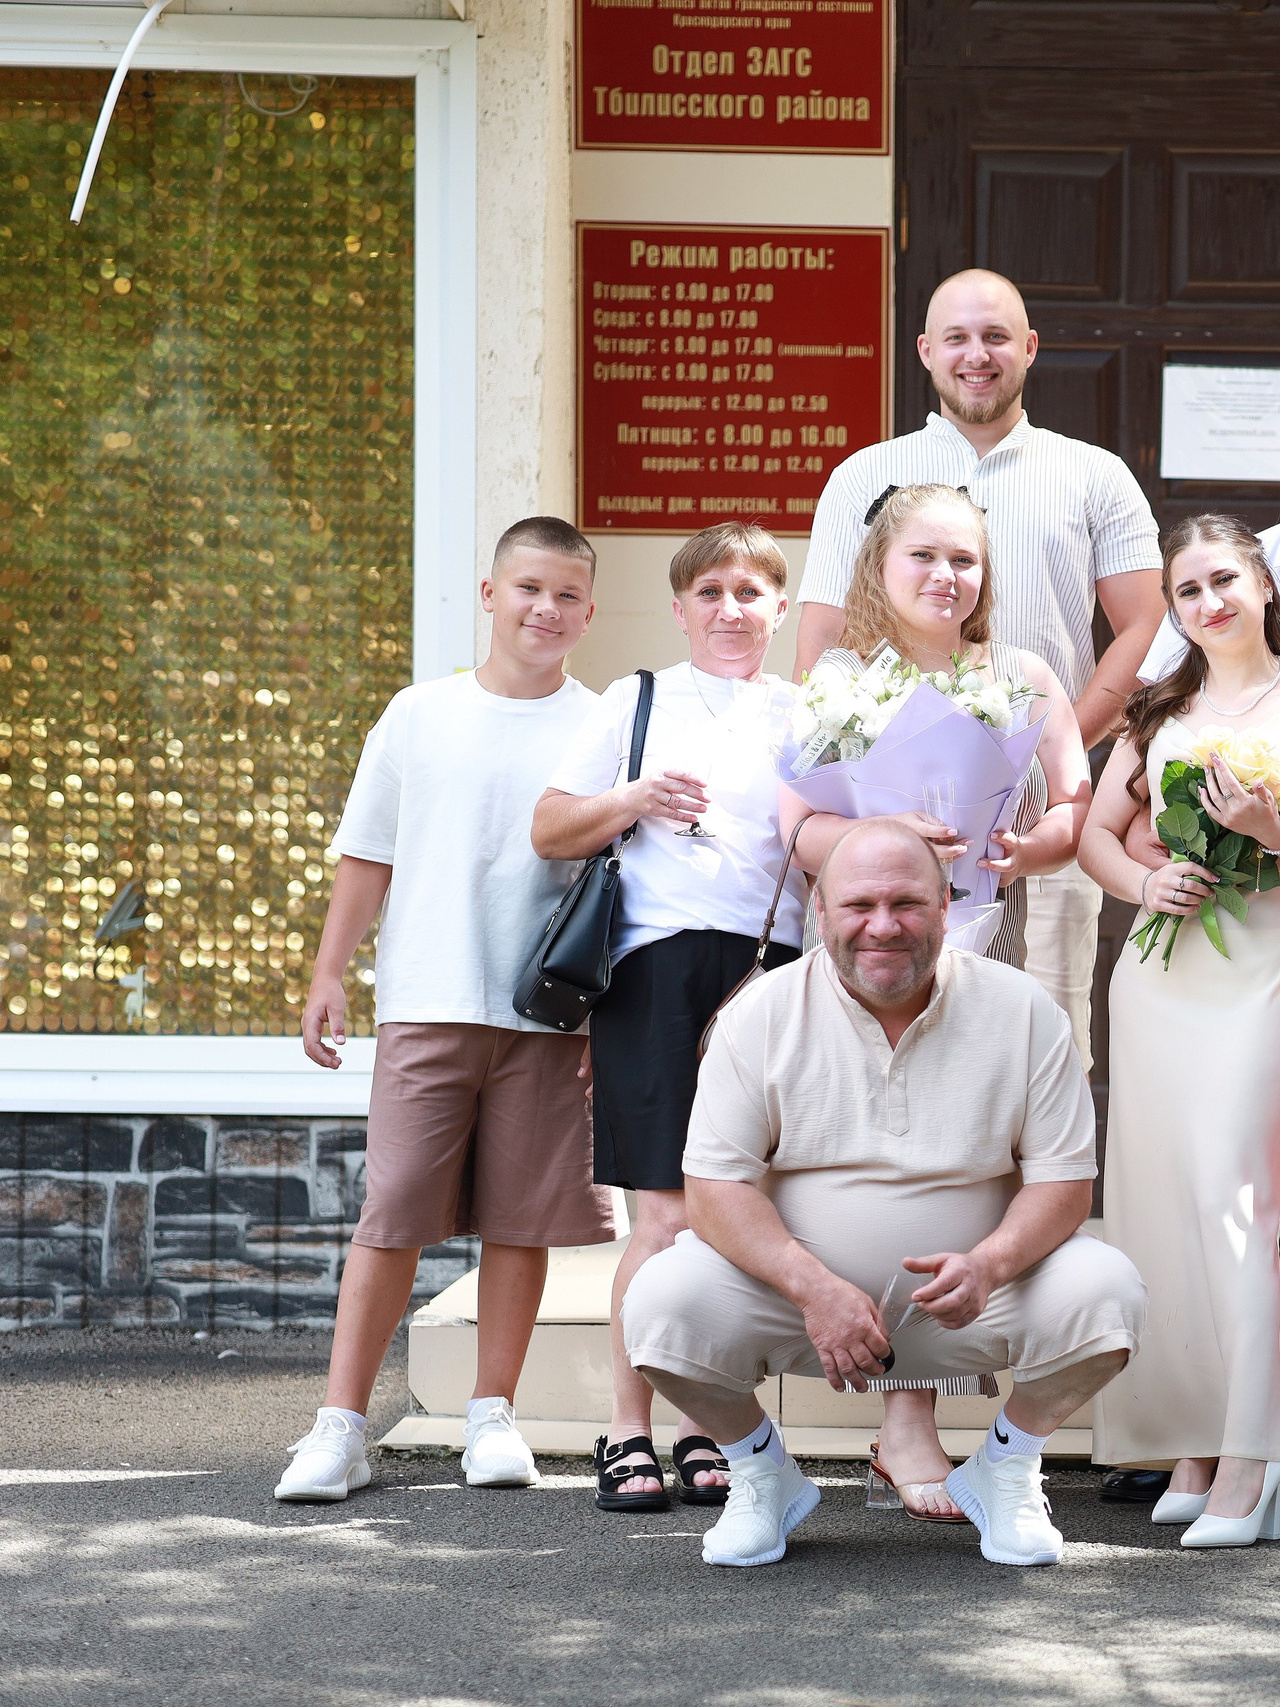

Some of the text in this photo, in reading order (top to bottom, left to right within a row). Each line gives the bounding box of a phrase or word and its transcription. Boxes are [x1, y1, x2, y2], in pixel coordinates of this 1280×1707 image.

[816, 1, 873, 12] состояния
[673, 14, 791, 29] Краснодарского края
[653, 45, 812, 78] Отдел ЗАГС
[594, 87, 870, 124] Тбилисского района
[631, 240, 834, 273] Режим работы:
[662, 286, 670, 300] с
[676, 283, 707, 301] 8.00
[712, 286, 730, 303] до
[736, 284, 773, 302] 17.00
[594, 308, 758, 330] Среда: с 8.00 до 17.00
[594, 335, 655, 355] Четверг:
[661, 339, 669, 354] с
[675, 336, 706, 354] 8.00
[711, 340, 729, 356] до
[735, 337, 772, 355] 17.00
[594, 362, 773, 383] Суббота: с 8.00 до 17.00
[711, 396, 720, 410] с
[767, 397, 785, 413] до
[618, 423, 847, 448] Пятница: с 8.00 до 16.00
[709, 457, 718, 471] с
[764, 458, 781, 474] до
